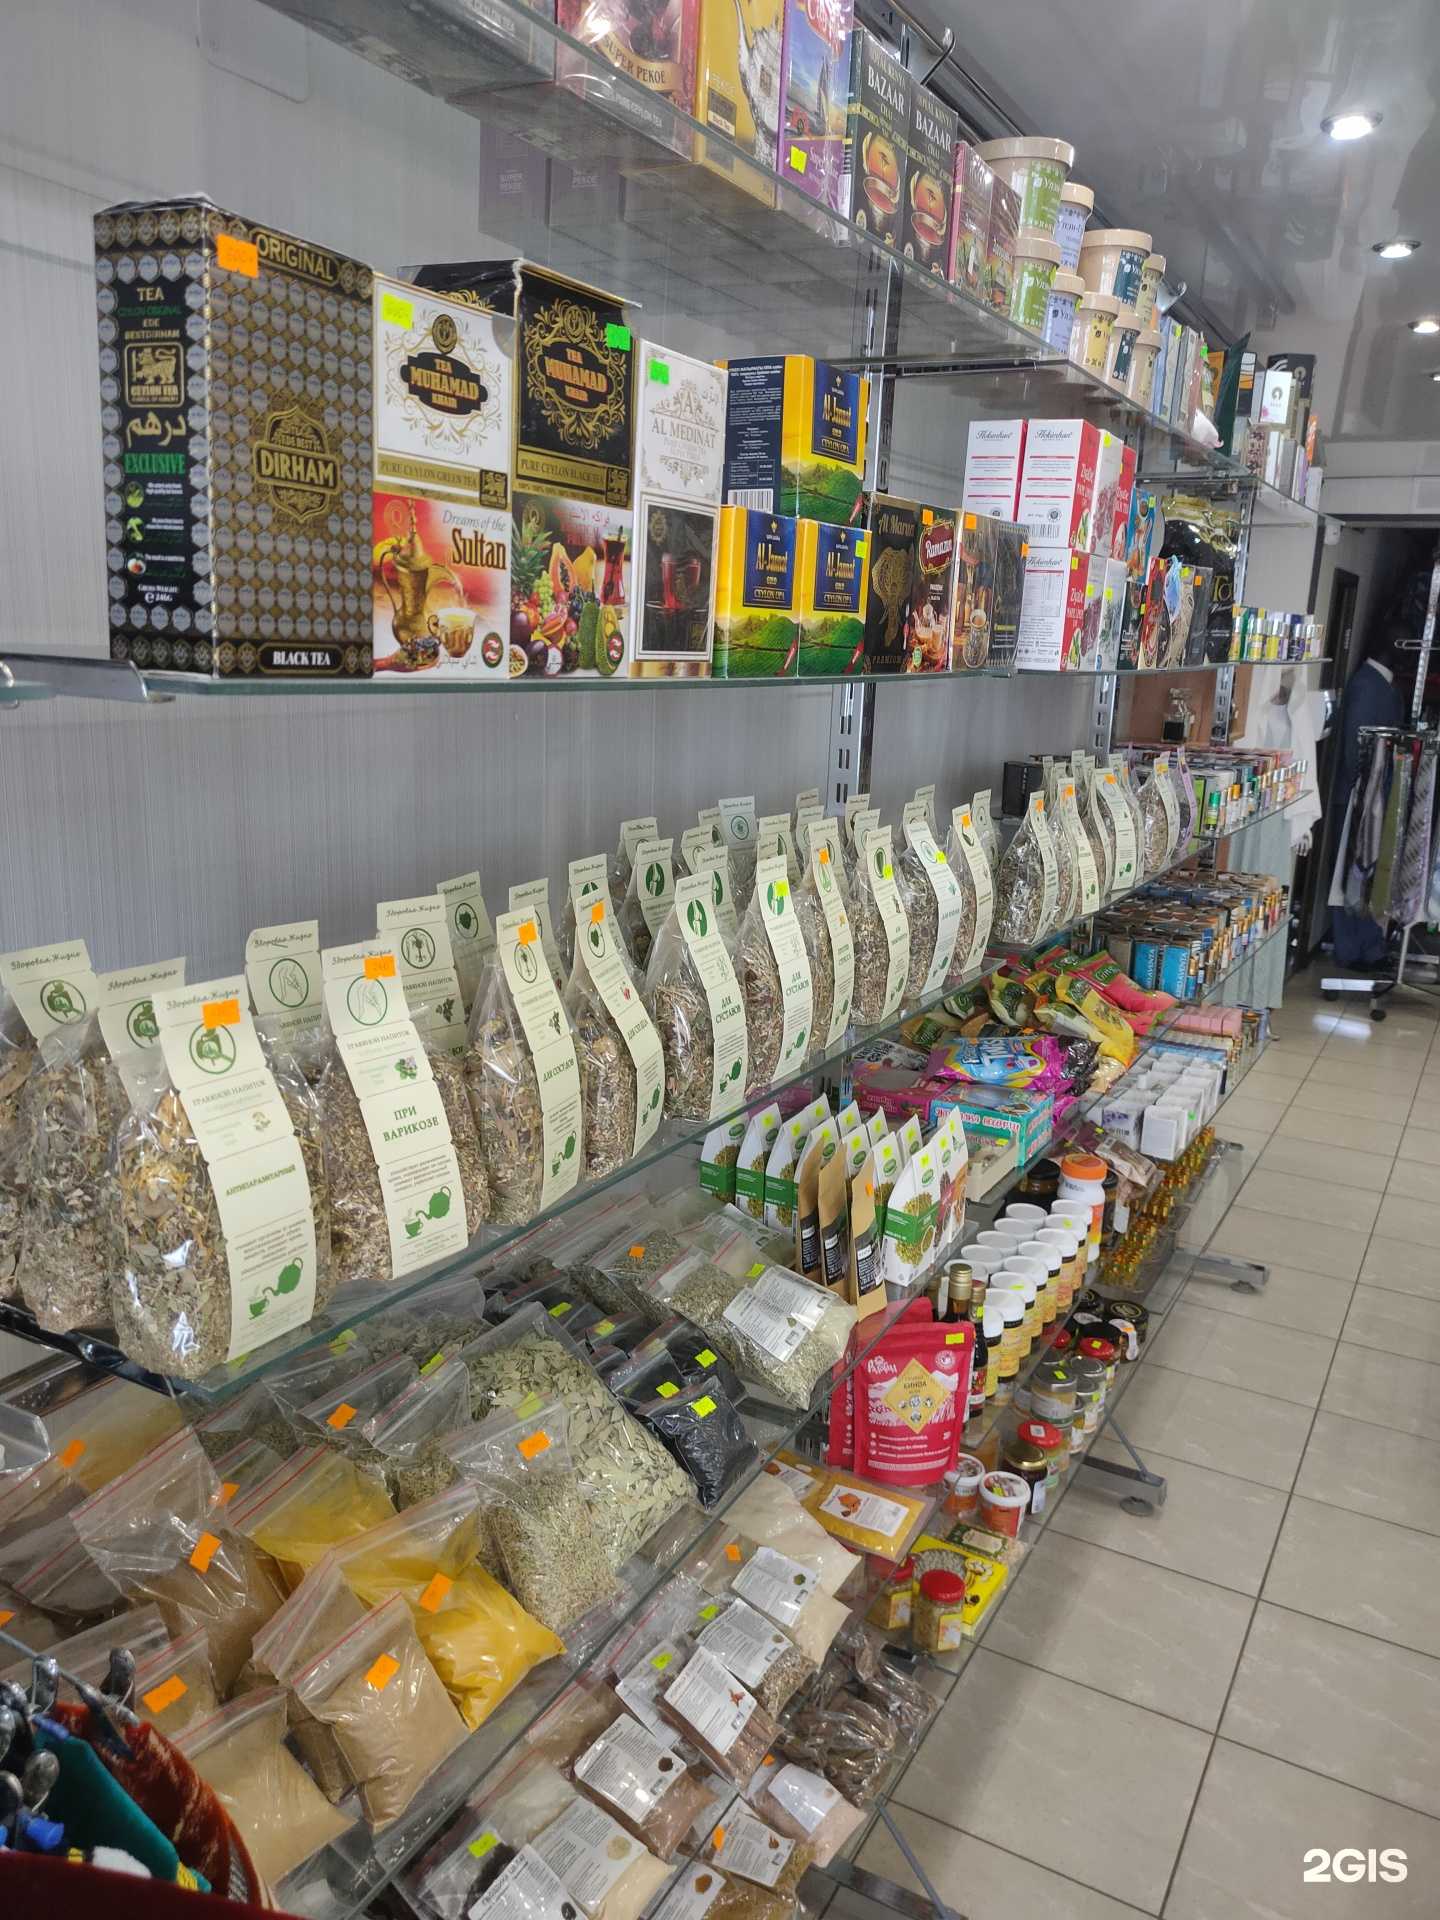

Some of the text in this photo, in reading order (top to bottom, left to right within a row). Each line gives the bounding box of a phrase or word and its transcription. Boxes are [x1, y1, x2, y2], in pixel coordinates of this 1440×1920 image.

[636, 66, 665, 84] PEKOE
[868, 64, 905, 116] BAZAAR
[916, 110, 951, 153] BAZAAR
[255, 234, 333, 280] ORIGINAL
[136, 287, 165, 302] TEA
[409, 365, 480, 401] MUHAMAD
[544, 356, 609, 393] MUHAMAD
[163, 384, 178, 396] TEA
[125, 411, 188, 448] درهم
[651, 416, 668, 436] AL
[669, 420, 717, 450] MEDINAT
[124, 453, 186, 475] EXCLUSIVE
[260, 450, 335, 488] DIRHAM
[442, 509, 506, 532] Dreams of the
[451, 527, 507, 571] Sultan
[272, 650, 331, 666] BLACK TEA
[785, 979, 810, 997] СУСТАВОВ
[791, 971, 802, 984] ДЛЯ
[721, 996, 732, 1009] ДЛЯ
[715, 1005, 742, 1025] СУСТАВОВ
[393, 1105, 418, 1121] ПРИ
[382, 1116, 440, 1142] ВАРИКОЗЕ
